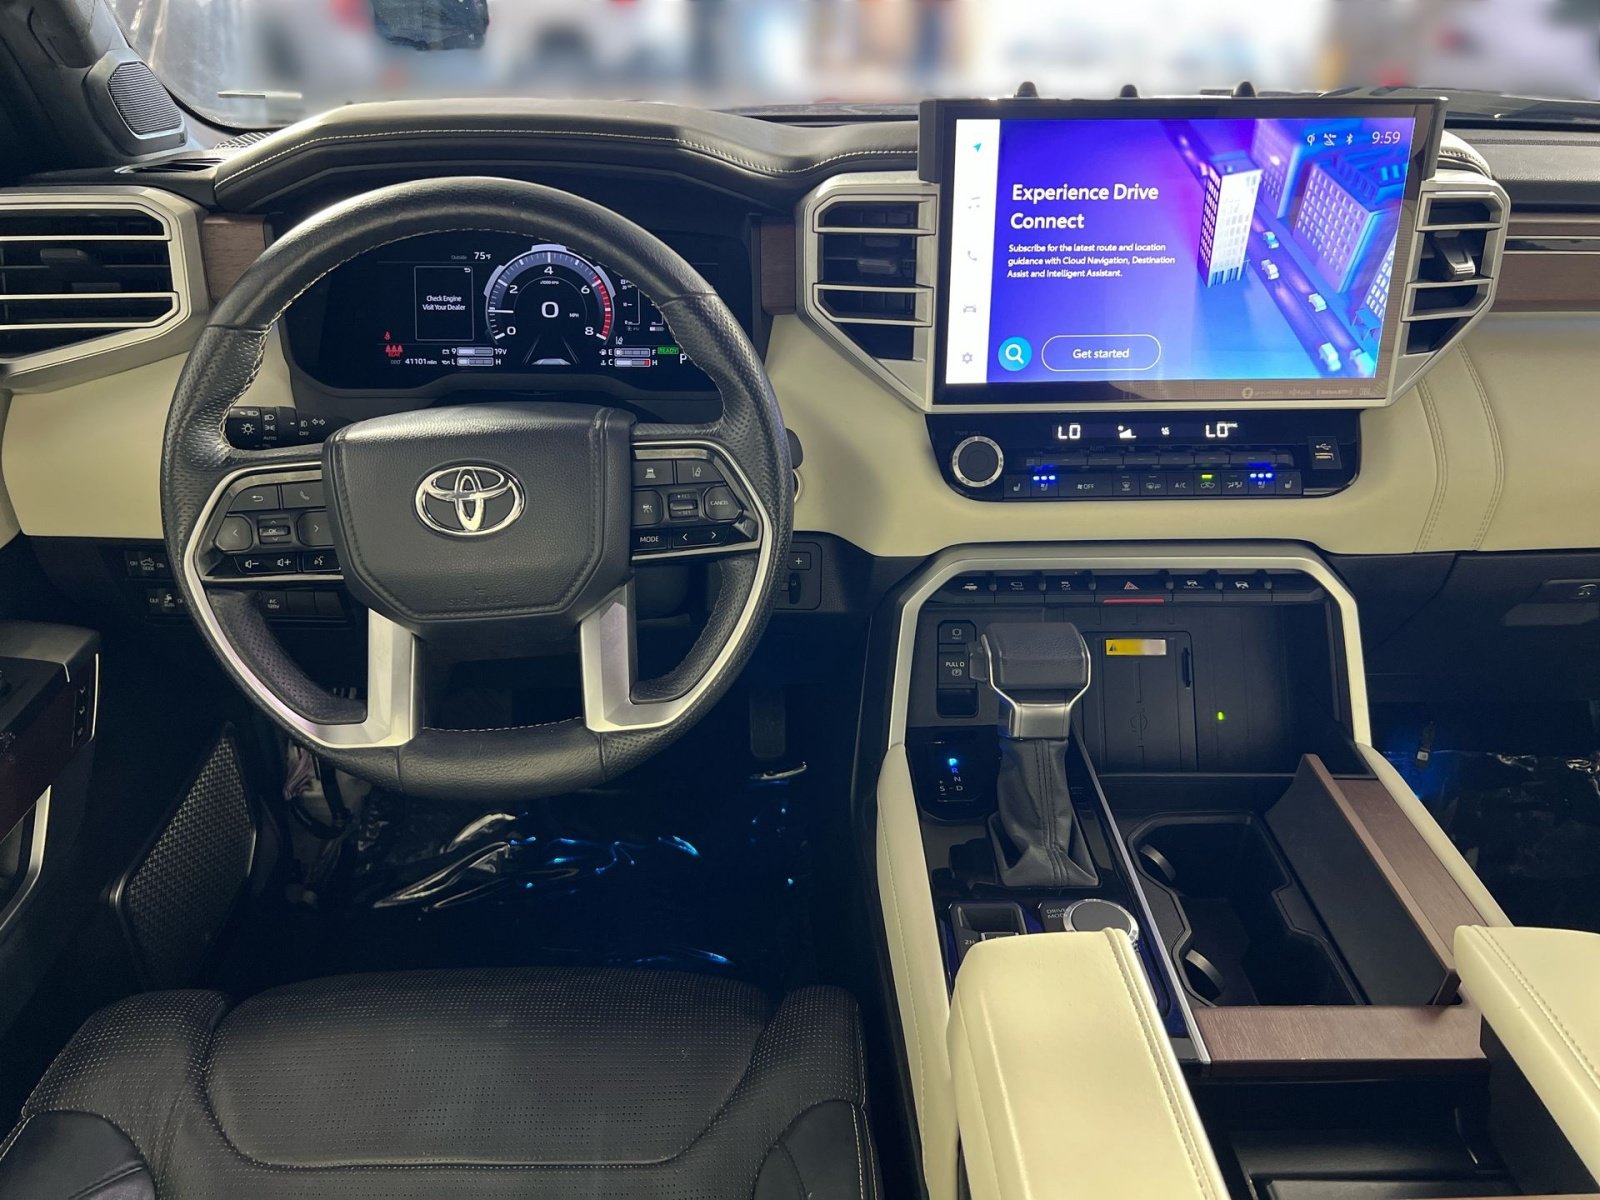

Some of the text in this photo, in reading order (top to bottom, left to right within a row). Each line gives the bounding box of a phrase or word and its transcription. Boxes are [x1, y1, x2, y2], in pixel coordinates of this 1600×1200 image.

[1371, 131, 1401, 144] 9:59
[1012, 183, 1159, 204] Experience Drive
[1010, 212, 1085, 229] Connect
[1008, 243, 1166, 252] Subscribe for the latest route and location
[1007, 256, 1175, 267] guidance with Cloud Navigation, Destination
[543, 266, 554, 275] 4
[1007, 269, 1123, 279] Assist and Intelligent Assistant.
[509, 284, 518, 294] 2
[580, 284, 590, 294] 6
[443, 295, 462, 303] Engine
[541, 301, 559, 318] 0
[507, 326, 516, 335] 0
[584, 326, 594, 335] 8
[1072, 348, 1130, 359] Get started
[679, 353, 687, 365] P
[1058, 424, 1081, 439] LO
[1205, 422, 1228, 438] LO
[640, 535, 659, 543] MODE
